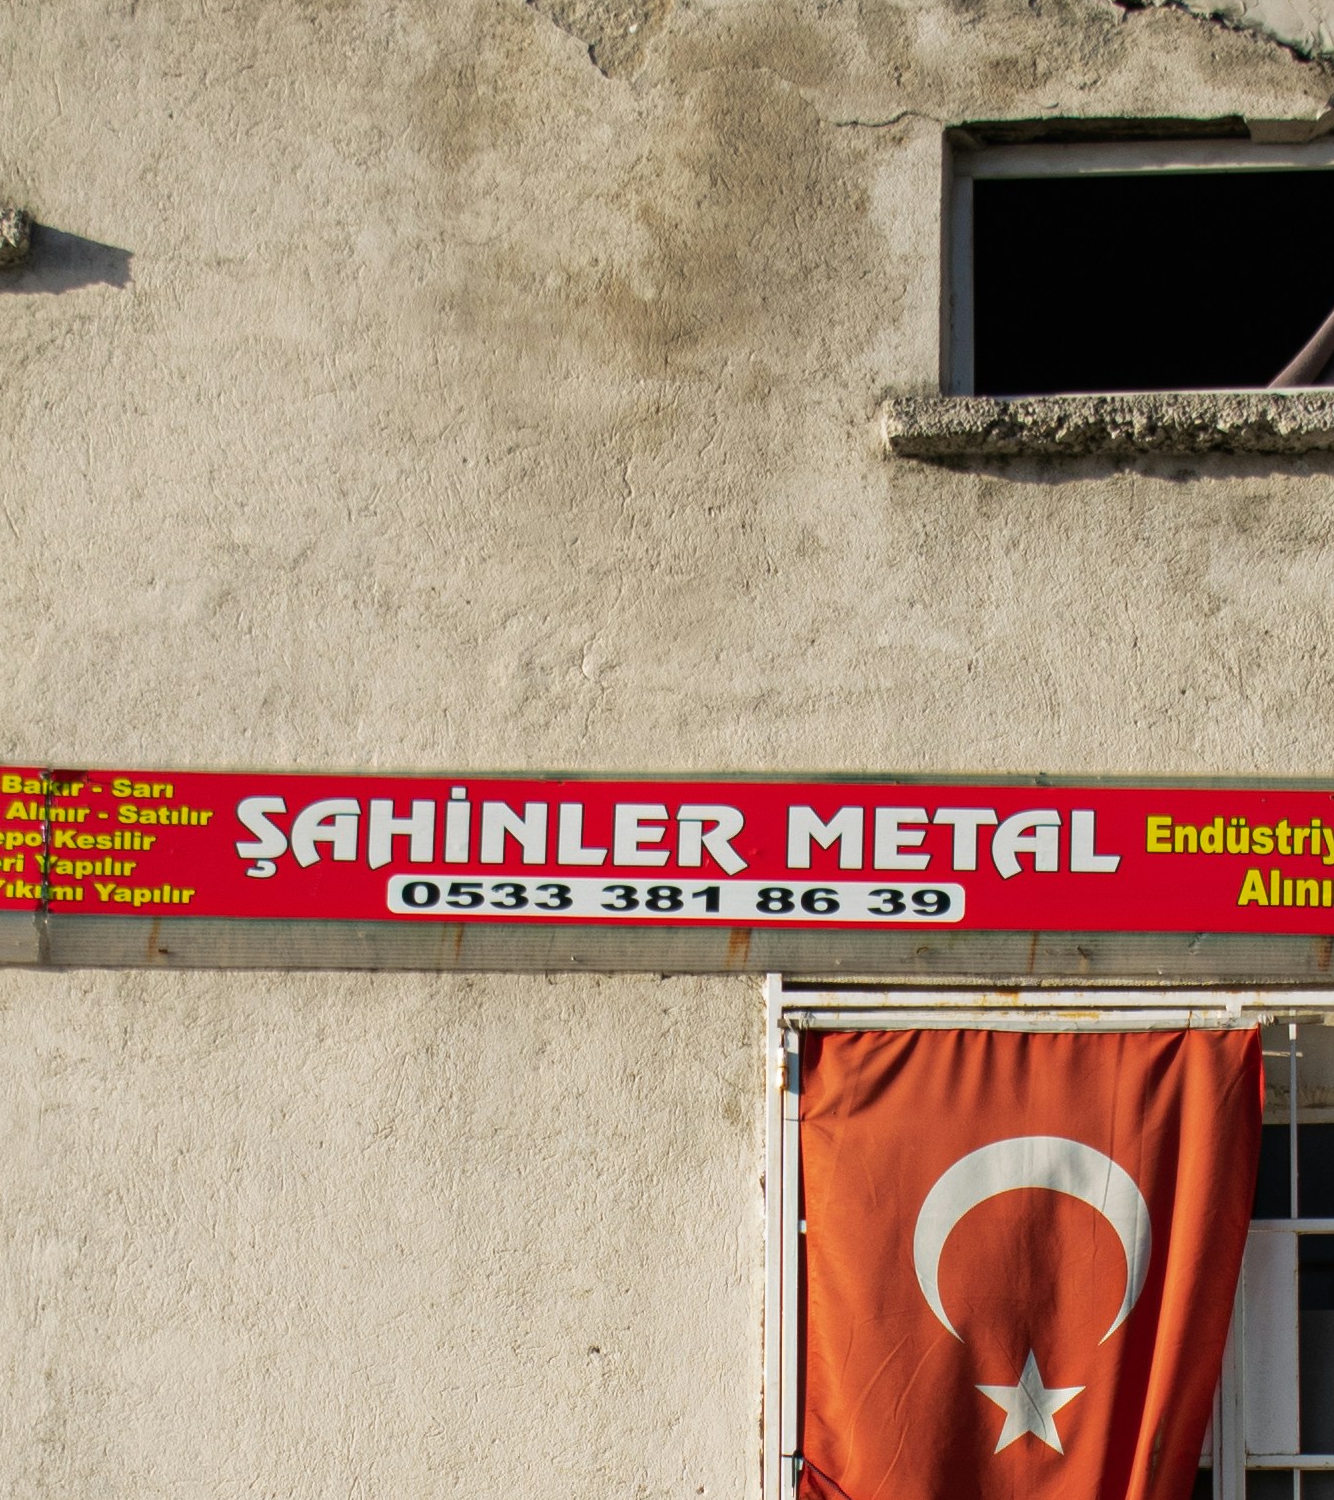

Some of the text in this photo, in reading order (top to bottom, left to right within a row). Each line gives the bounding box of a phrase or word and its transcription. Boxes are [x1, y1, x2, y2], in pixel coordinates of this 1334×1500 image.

[1, 774, 84, 797] Bakır
[112, 778, 174, 799] Sarı
[6, 801, 90, 823] Alınır
[118, 804, 213, 827] Satılır
[54, 829, 157, 851] Kesilir
[235, 786, 1122, 880] ŞAHİNLER METAL
[34, 854, 137, 880] Yapılır
[94, 882, 196, 907] Yapılır
[401, 880, 952, 917] 0533 381 86 39
